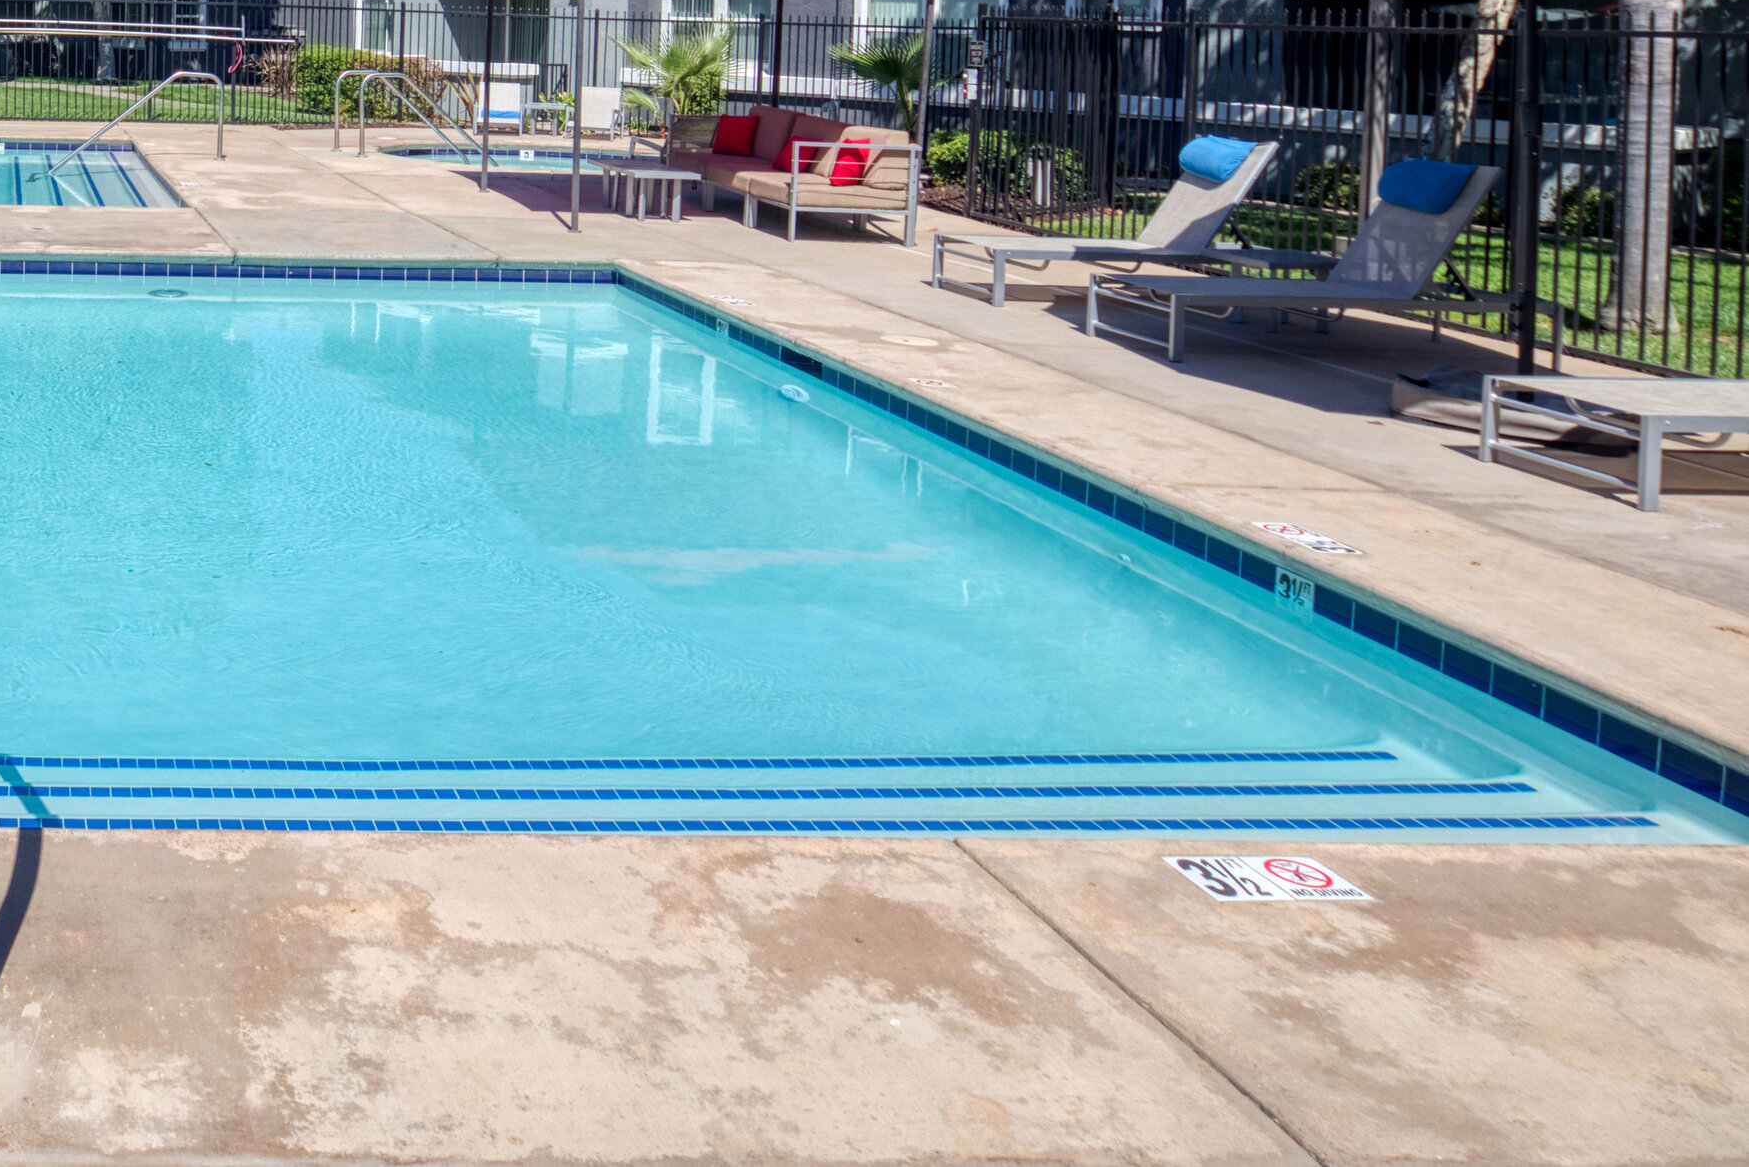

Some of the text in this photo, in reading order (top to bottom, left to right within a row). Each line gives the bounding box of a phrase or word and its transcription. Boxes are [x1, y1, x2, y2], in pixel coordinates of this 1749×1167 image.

[1221, 858, 1243, 869] FT
[1292, 888, 1364, 897] NO DIVING
